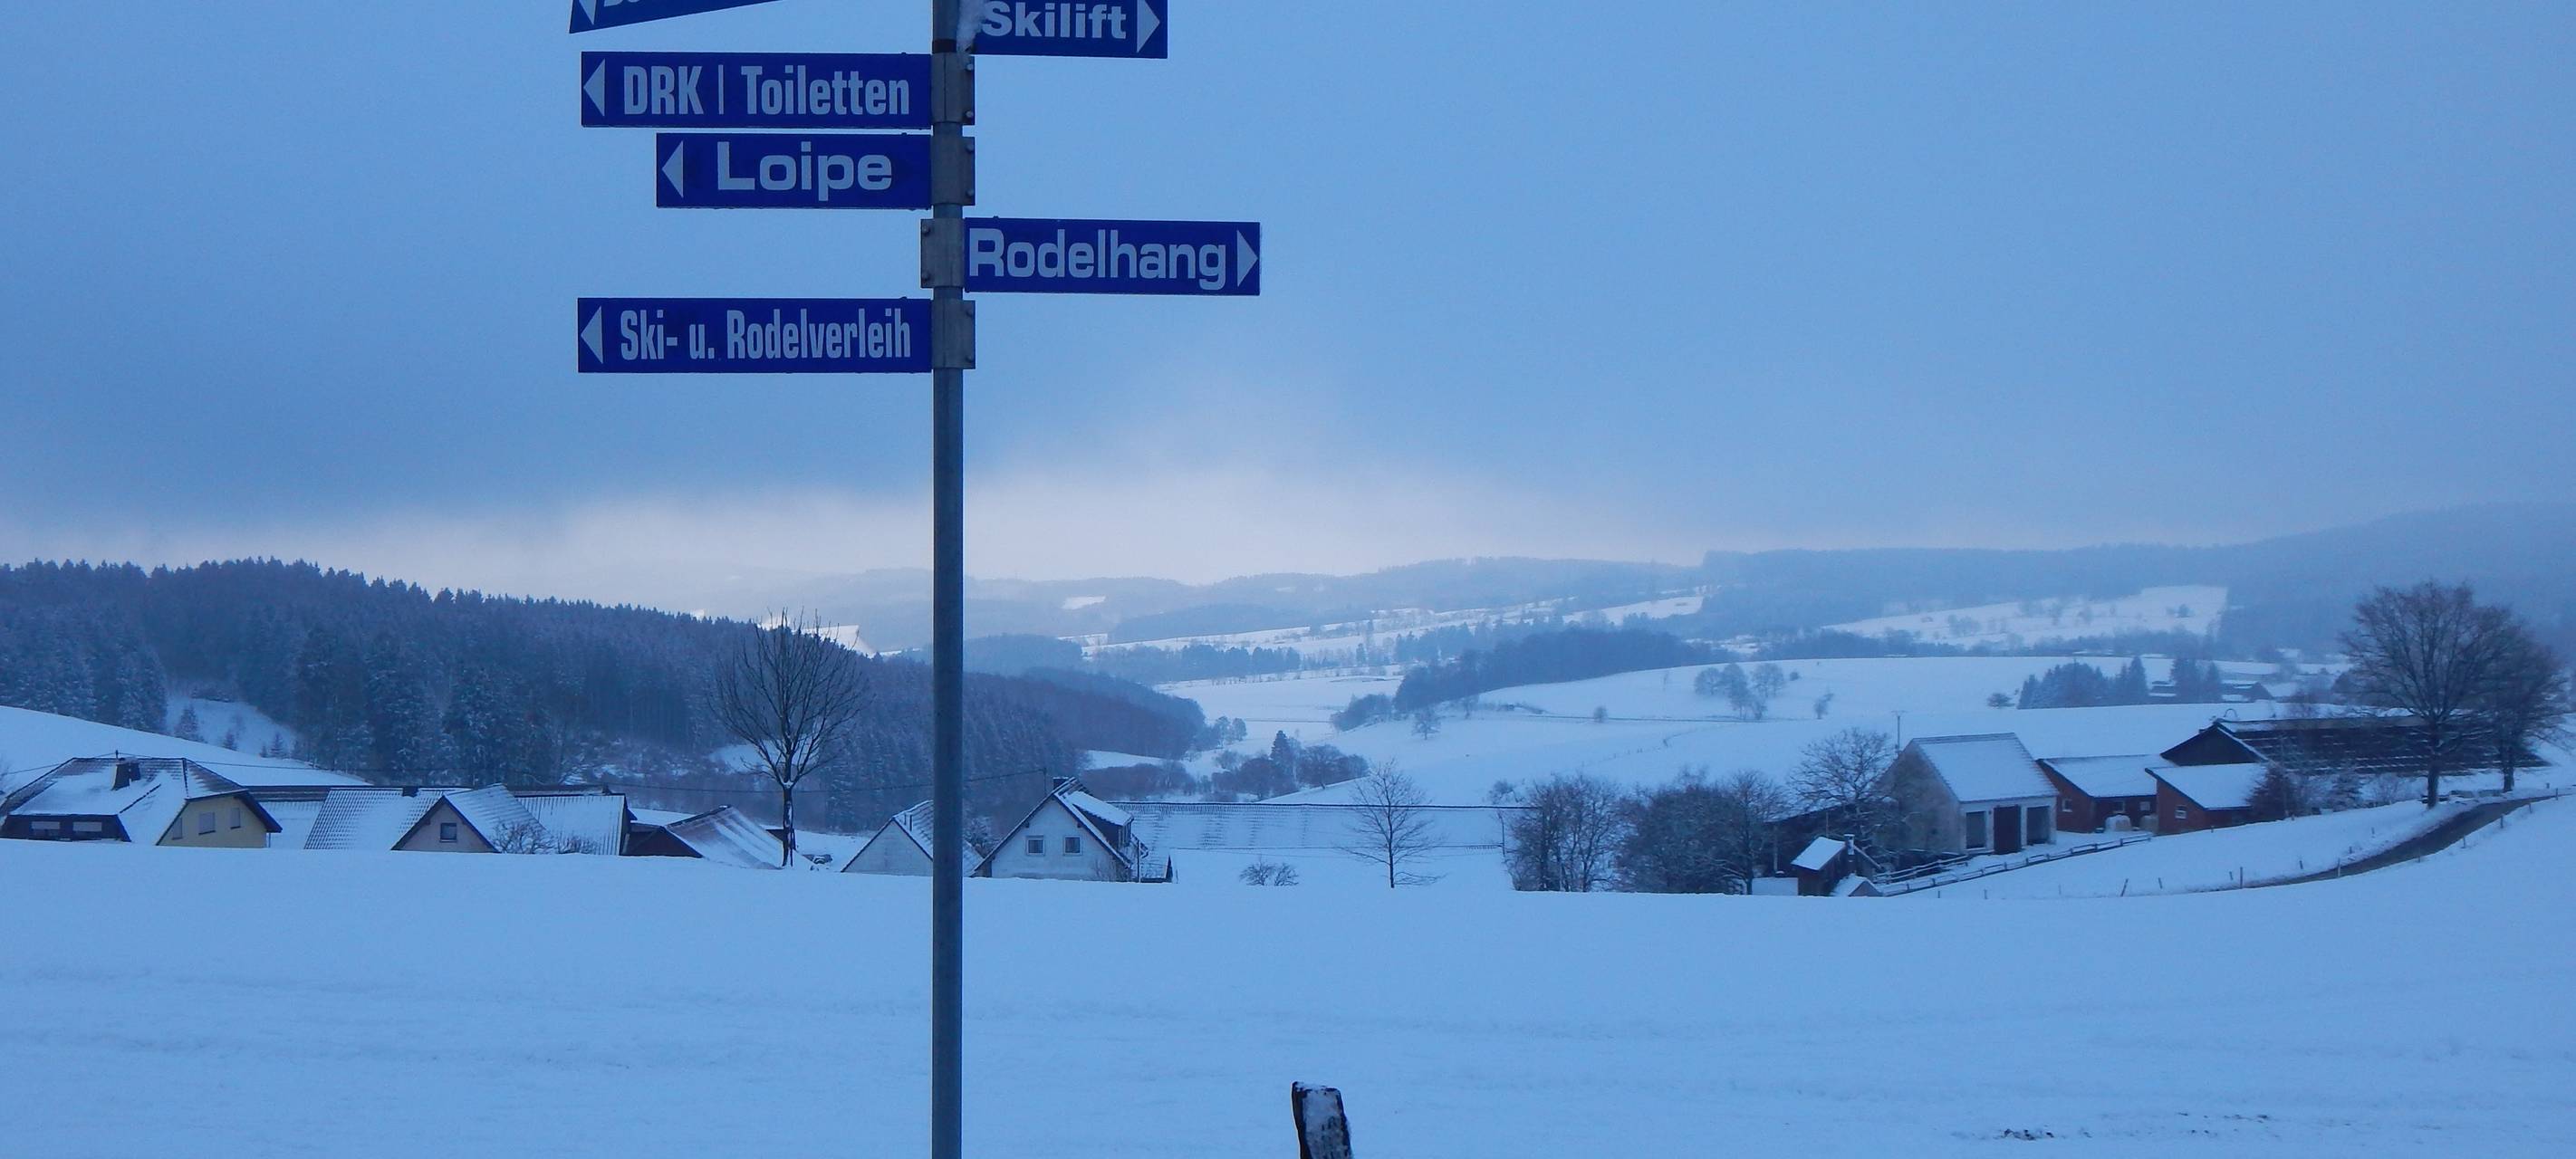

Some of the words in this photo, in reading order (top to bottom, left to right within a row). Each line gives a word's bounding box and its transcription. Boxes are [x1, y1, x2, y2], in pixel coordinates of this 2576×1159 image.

[981, 0, 1127, 39] Skilift
[623, 65, 704, 115] DRK
[741, 64, 909, 115] Toiletten
[716, 141, 892, 202] Loipe
[969, 228, 1226, 291] Rodelhang
[620, 309, 678, 360] Ski-
[689, 324, 715, 359] u.
[726, 308, 910, 359] Rodelverleih
